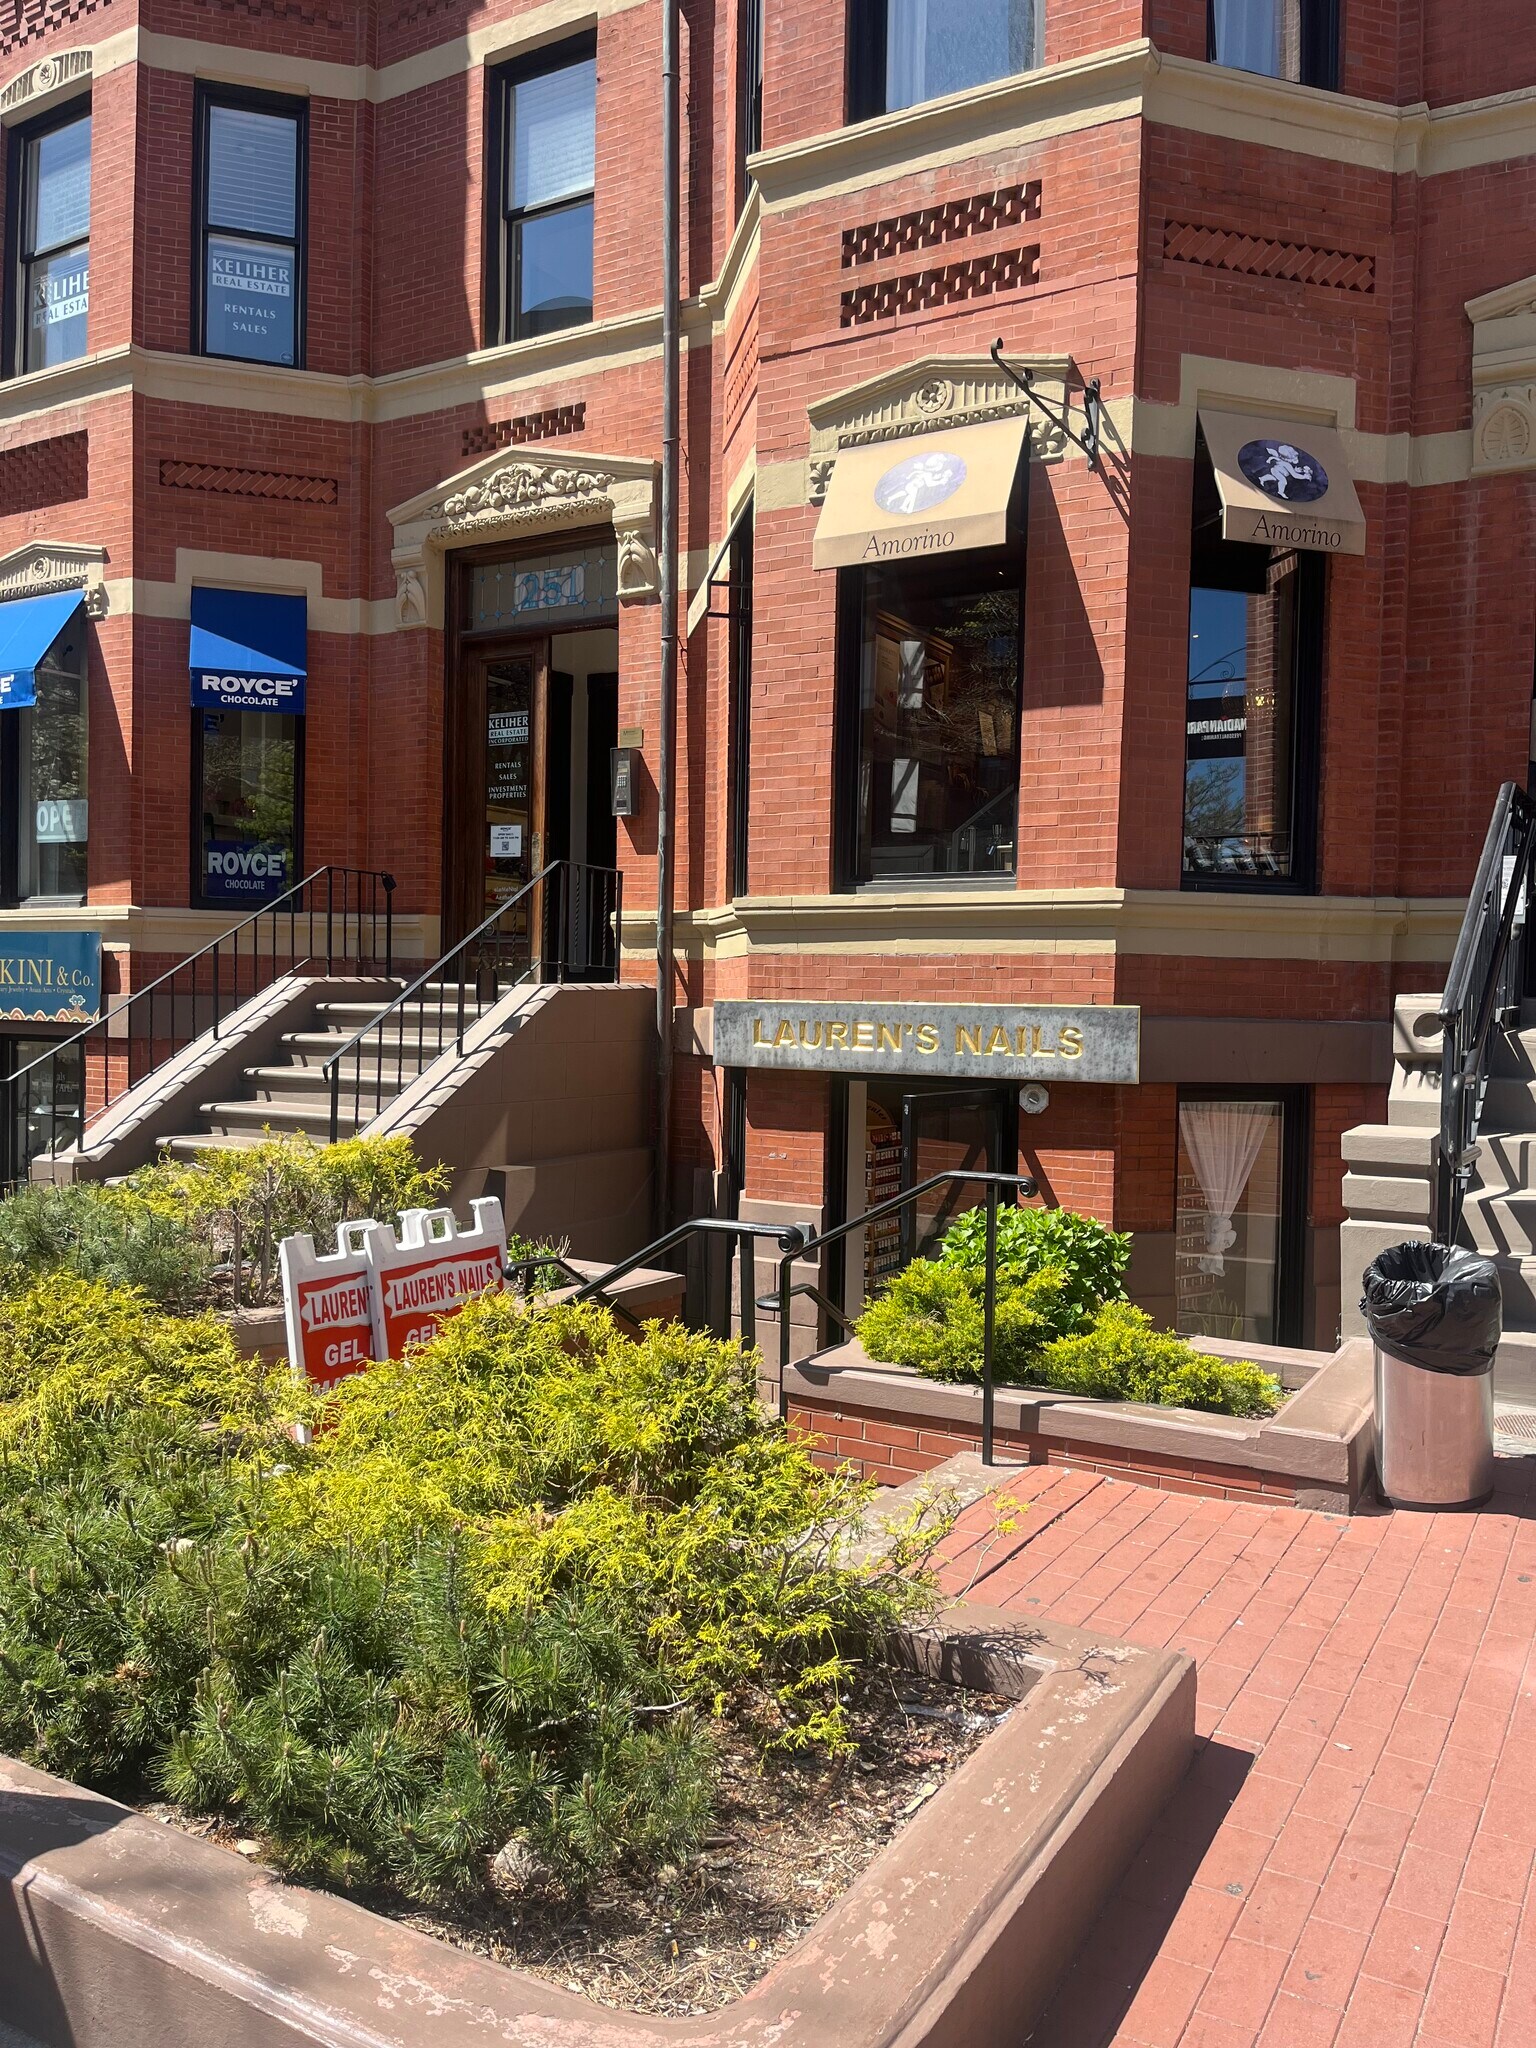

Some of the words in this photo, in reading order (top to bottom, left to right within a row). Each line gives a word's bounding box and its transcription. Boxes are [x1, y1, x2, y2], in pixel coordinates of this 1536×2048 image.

[212, 258, 290, 283] KELIHER
[216, 275, 242, 287] REAL
[247, 280, 286, 294] ESTATE
[224, 303, 276, 319] RENTALS
[232, 321, 268, 335] SALES
[1251, 514, 1341, 548] Amorino
[861, 528, 955, 558] Amorino
[520, 568, 578, 610] 251
[201, 674, 298, 697] ROYCE'
[220, 694, 279, 706] CHOCOLATE
[488, 716, 529, 729] KELIHER
[506, 728, 527, 736] ESTATE
[488, 736, 529, 744] INCORPORATED
[494, 761, 522, 770] RENTALS
[488, 784, 527, 793] INVESTMENT
[489, 791, 527, 800] PROPERTIES
[36, 804, 74, 833] OPE
[207, 851, 287, 877] ROYCE'
[224, 878, 266, 890] CHOCOLATE
[0, 958, 54, 986] KINI
[56, 965, 70, 986] &
[72, 969, 95, 987] Co.
[752, 1018, 940, 1055] LAUREN'S
[955, 1023, 1084, 1060] NAILS
[393, 1271, 456, 1311] LAUREN'S
[458, 1262, 494, 1295] NAILS
[311, 1285, 370, 1326] LAUREN'
[324, 1338, 364, 1367] GEL
